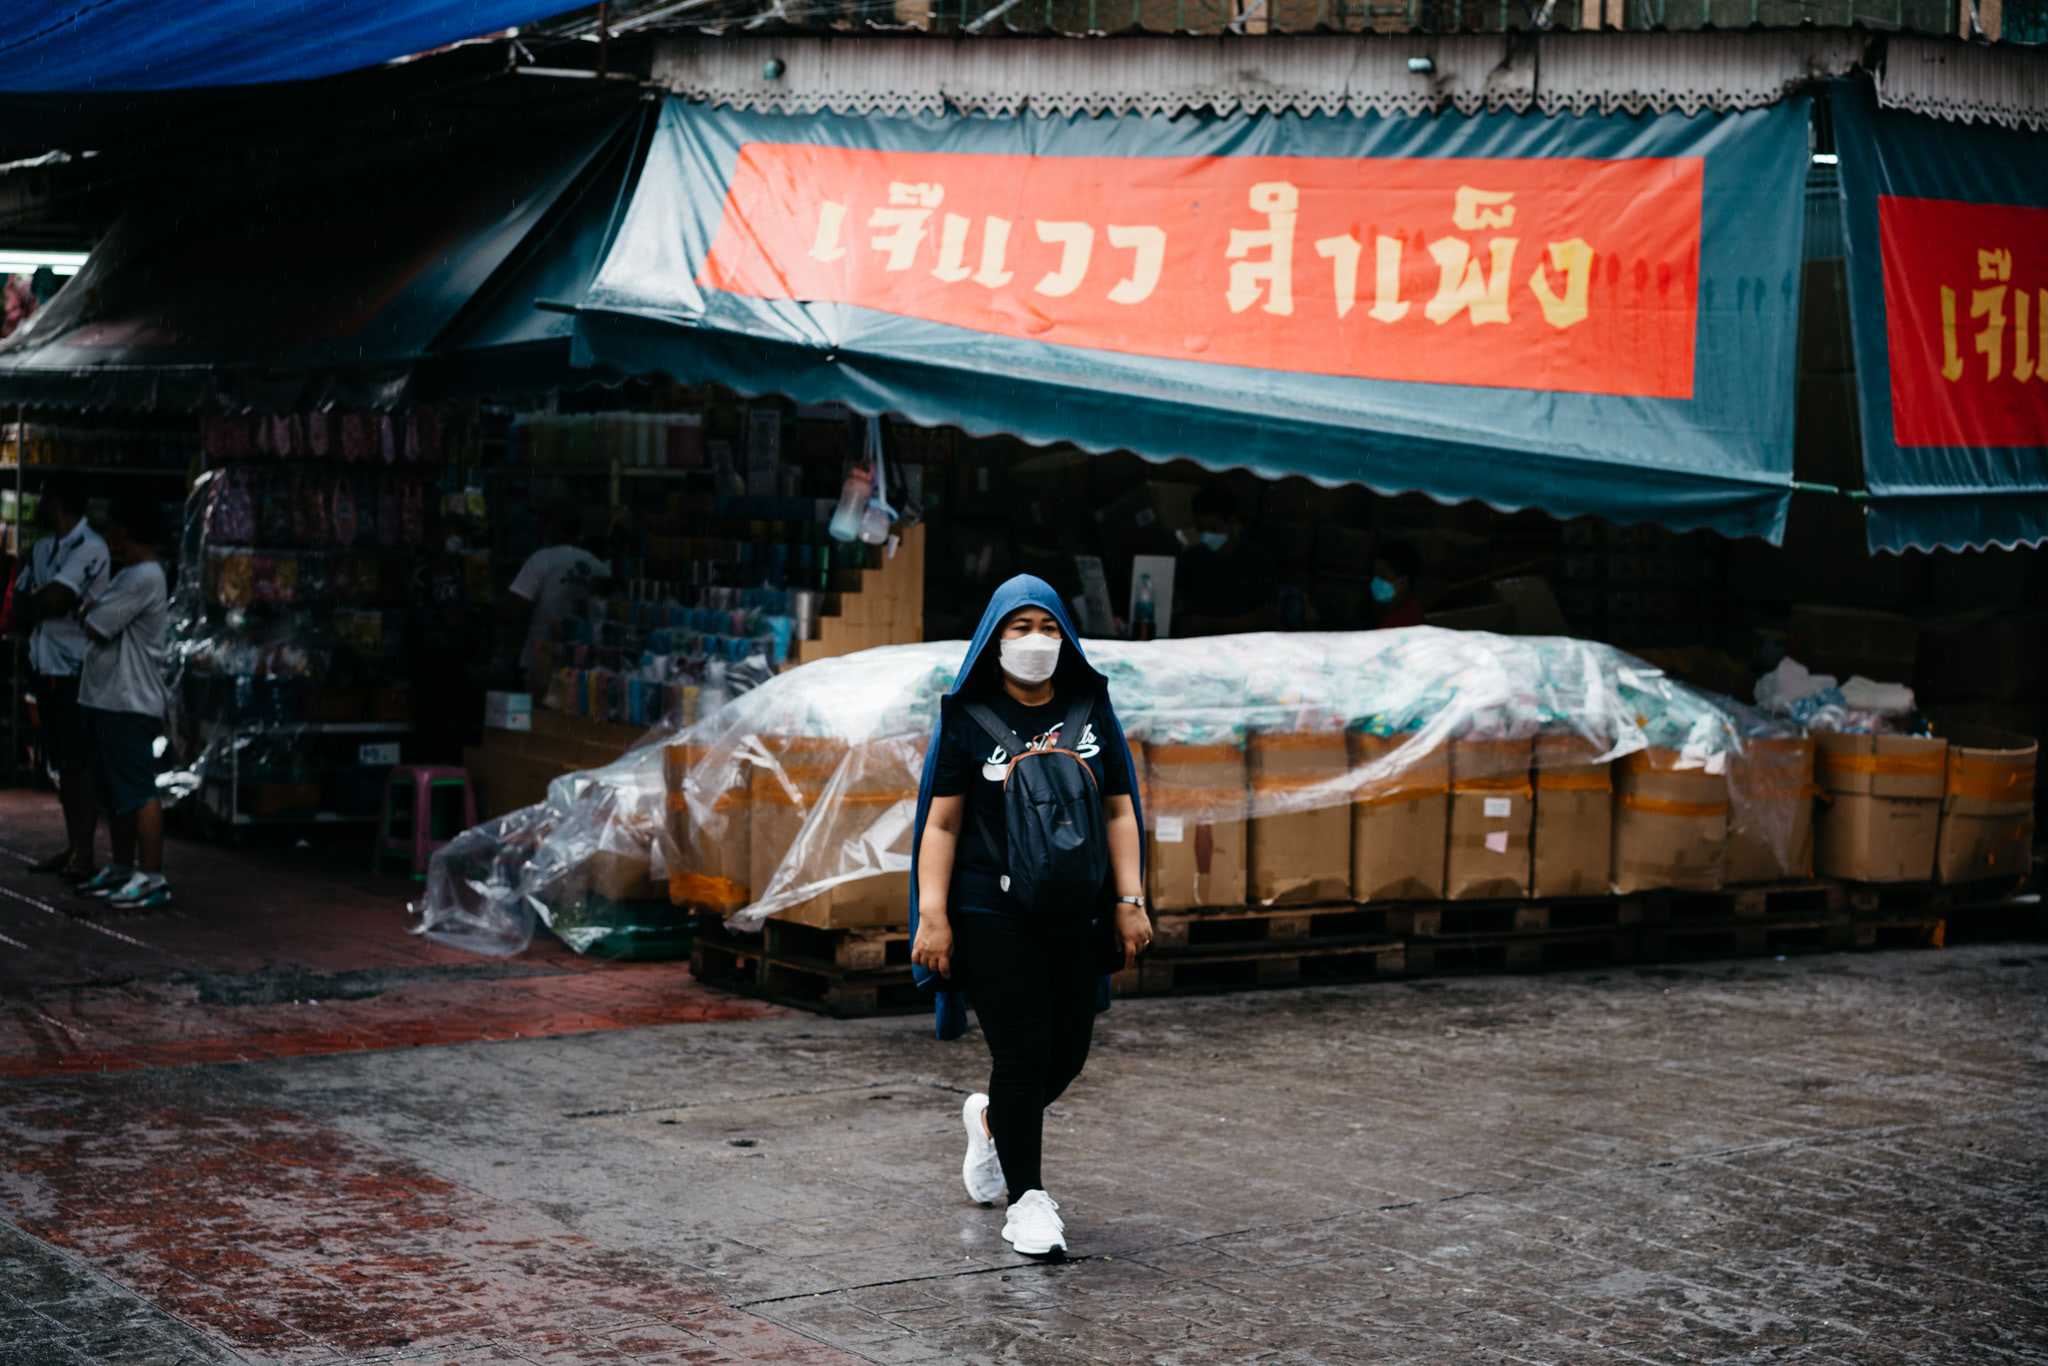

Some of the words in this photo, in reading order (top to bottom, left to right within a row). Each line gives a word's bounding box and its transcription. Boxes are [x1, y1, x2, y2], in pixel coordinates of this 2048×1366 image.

[808, 182, 1167, 304] เจ๊แวว
[1224, 181, 1595, 329] สำเพ็ง
